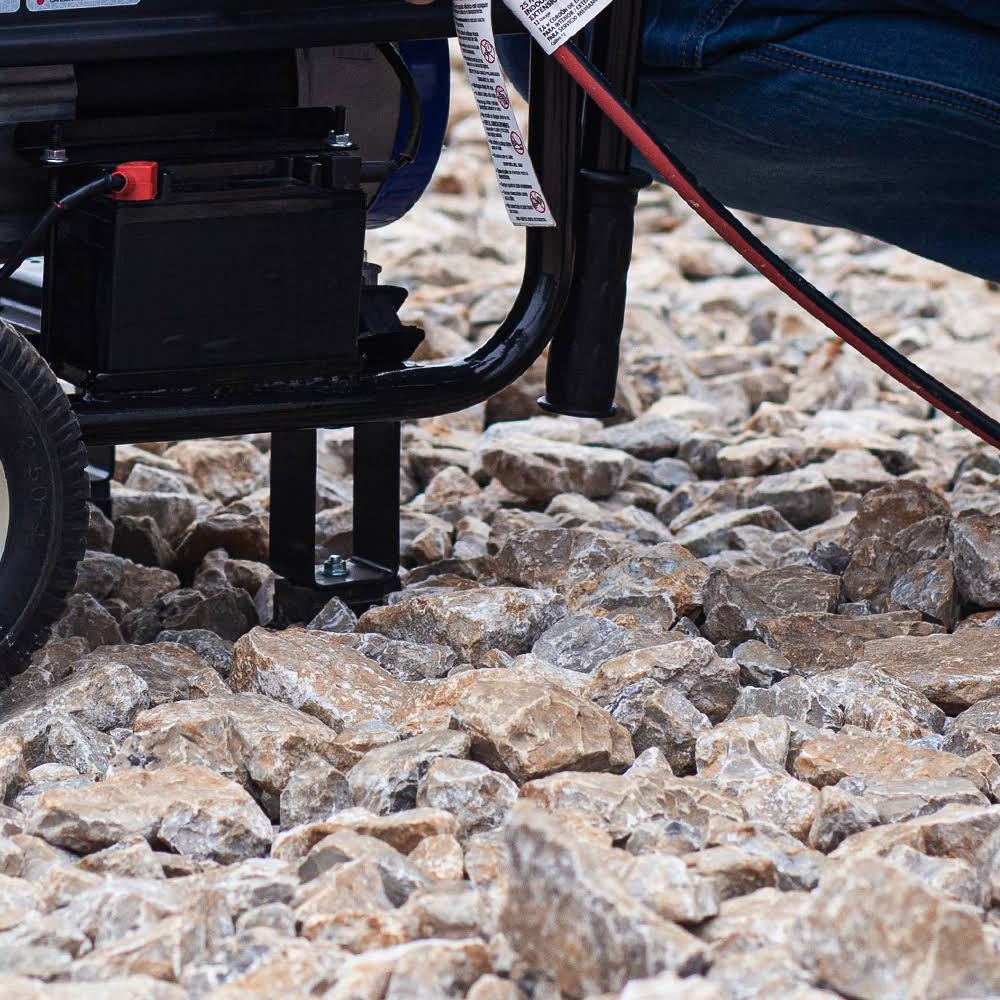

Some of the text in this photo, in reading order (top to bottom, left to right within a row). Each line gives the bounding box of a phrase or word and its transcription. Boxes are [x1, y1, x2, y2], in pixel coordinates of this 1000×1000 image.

[543, 26, 555, 37] PARA
[555, 10, 576, 27] INTERIOR
[547, 31, 559, 42] PARA
[559, 15, 578, 33] SERVICIO
